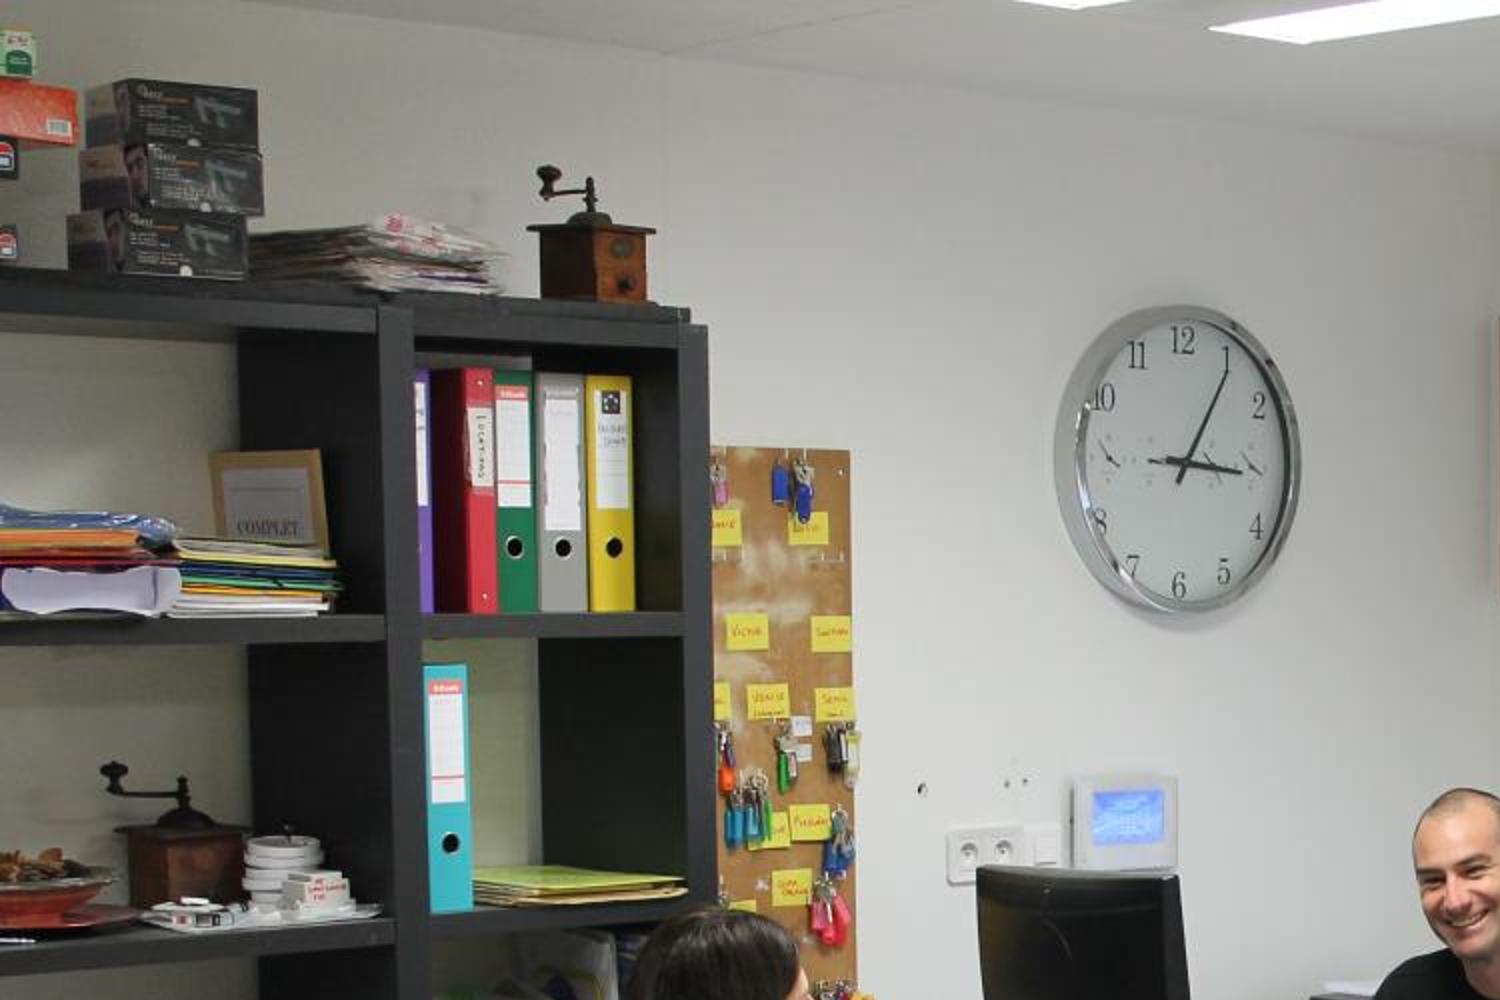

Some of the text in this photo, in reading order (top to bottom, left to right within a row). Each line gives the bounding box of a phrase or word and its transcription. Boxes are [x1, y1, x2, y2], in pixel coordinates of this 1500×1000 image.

[1170, 325, 1196, 355] 12
[1127, 340, 1147, 370] 11
[1221, 346, 1231, 371] 1
[1092, 382, 1116, 413] 10
[1251, 391, 1267, 420] 2
[236, 518, 300, 538] COMPLET
[1091, 507, 1108, 536] 8
[1248, 512, 1265, 541] 4
[1125, 554, 1141, 580] 7
[1216, 557, 1232, 586] 5
[1171, 571, 1188, 599] 6
